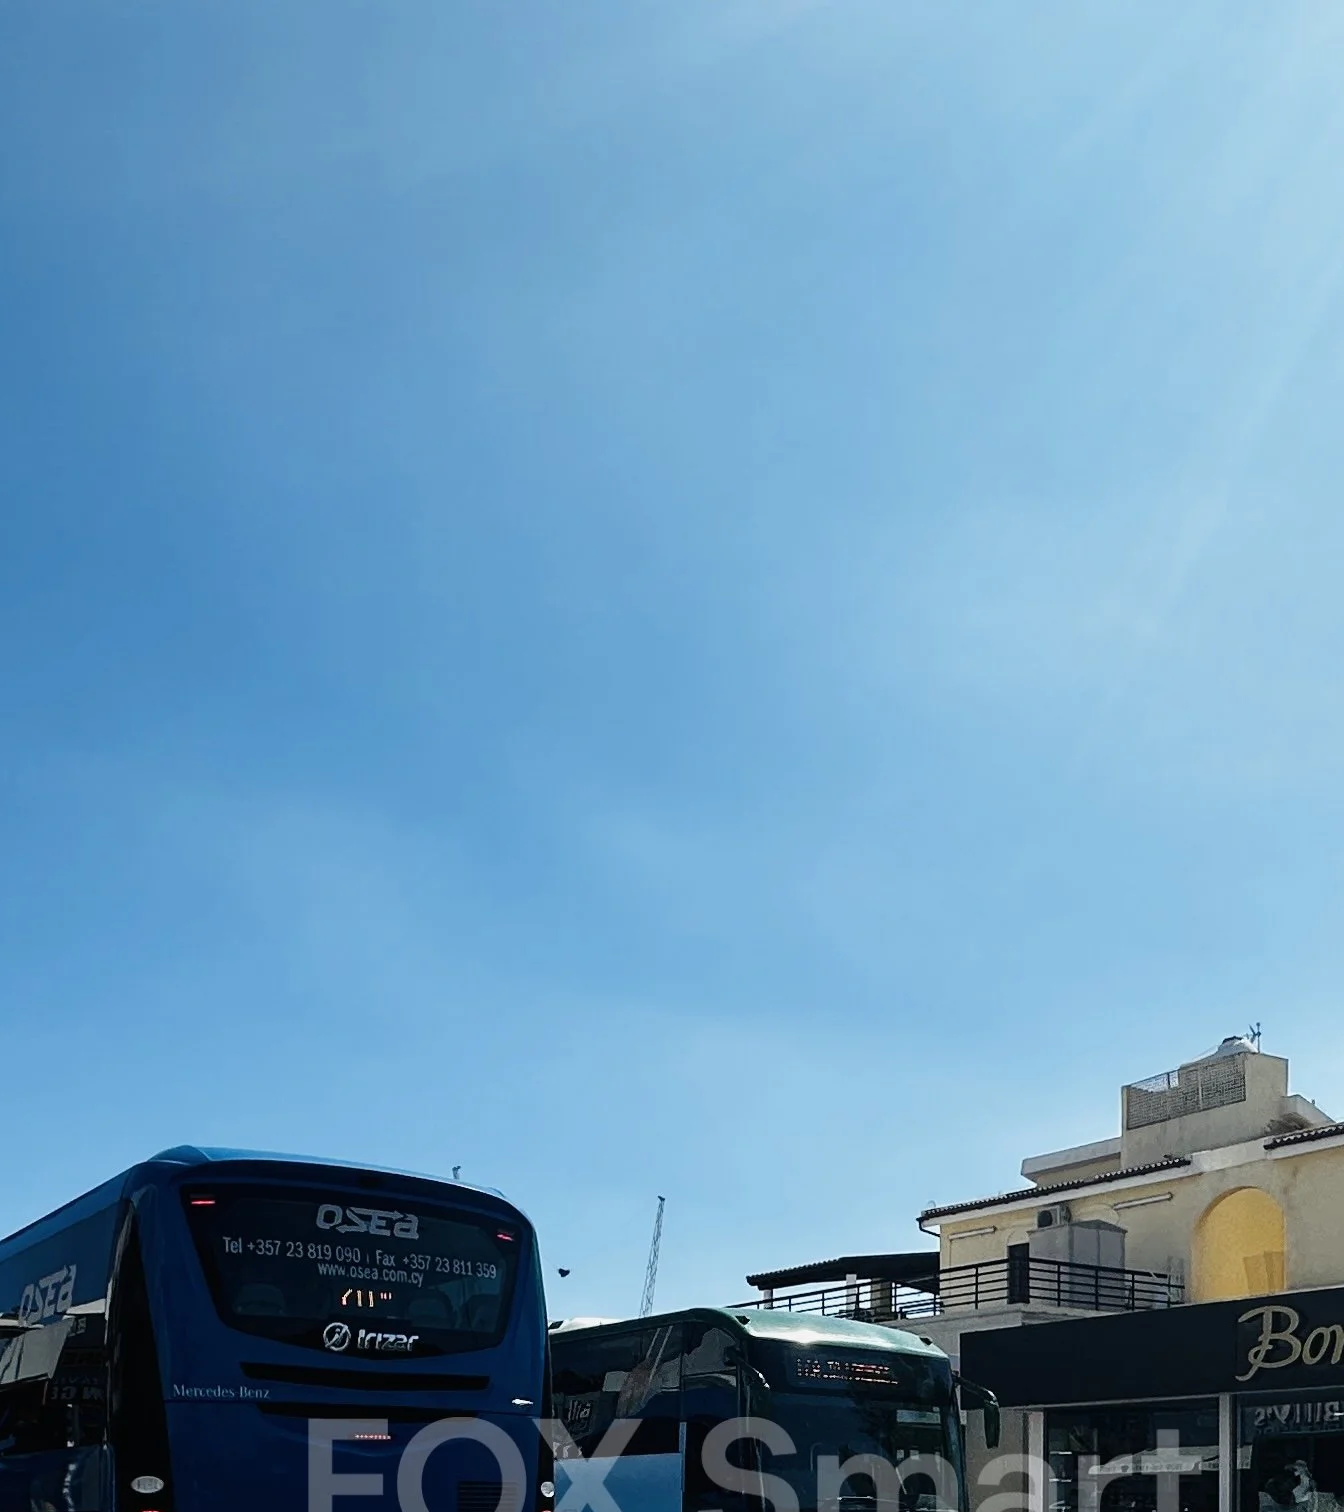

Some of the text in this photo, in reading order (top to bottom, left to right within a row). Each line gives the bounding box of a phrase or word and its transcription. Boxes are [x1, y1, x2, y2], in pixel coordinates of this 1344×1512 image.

[223, 1236, 497, 1279] Tel +357 23 819 090 Fax +357 23 811 359
[318, 1261, 425, 1288] www.osea.com.cy
[172, 1383, 272, 1401] Mercedes-Benz
